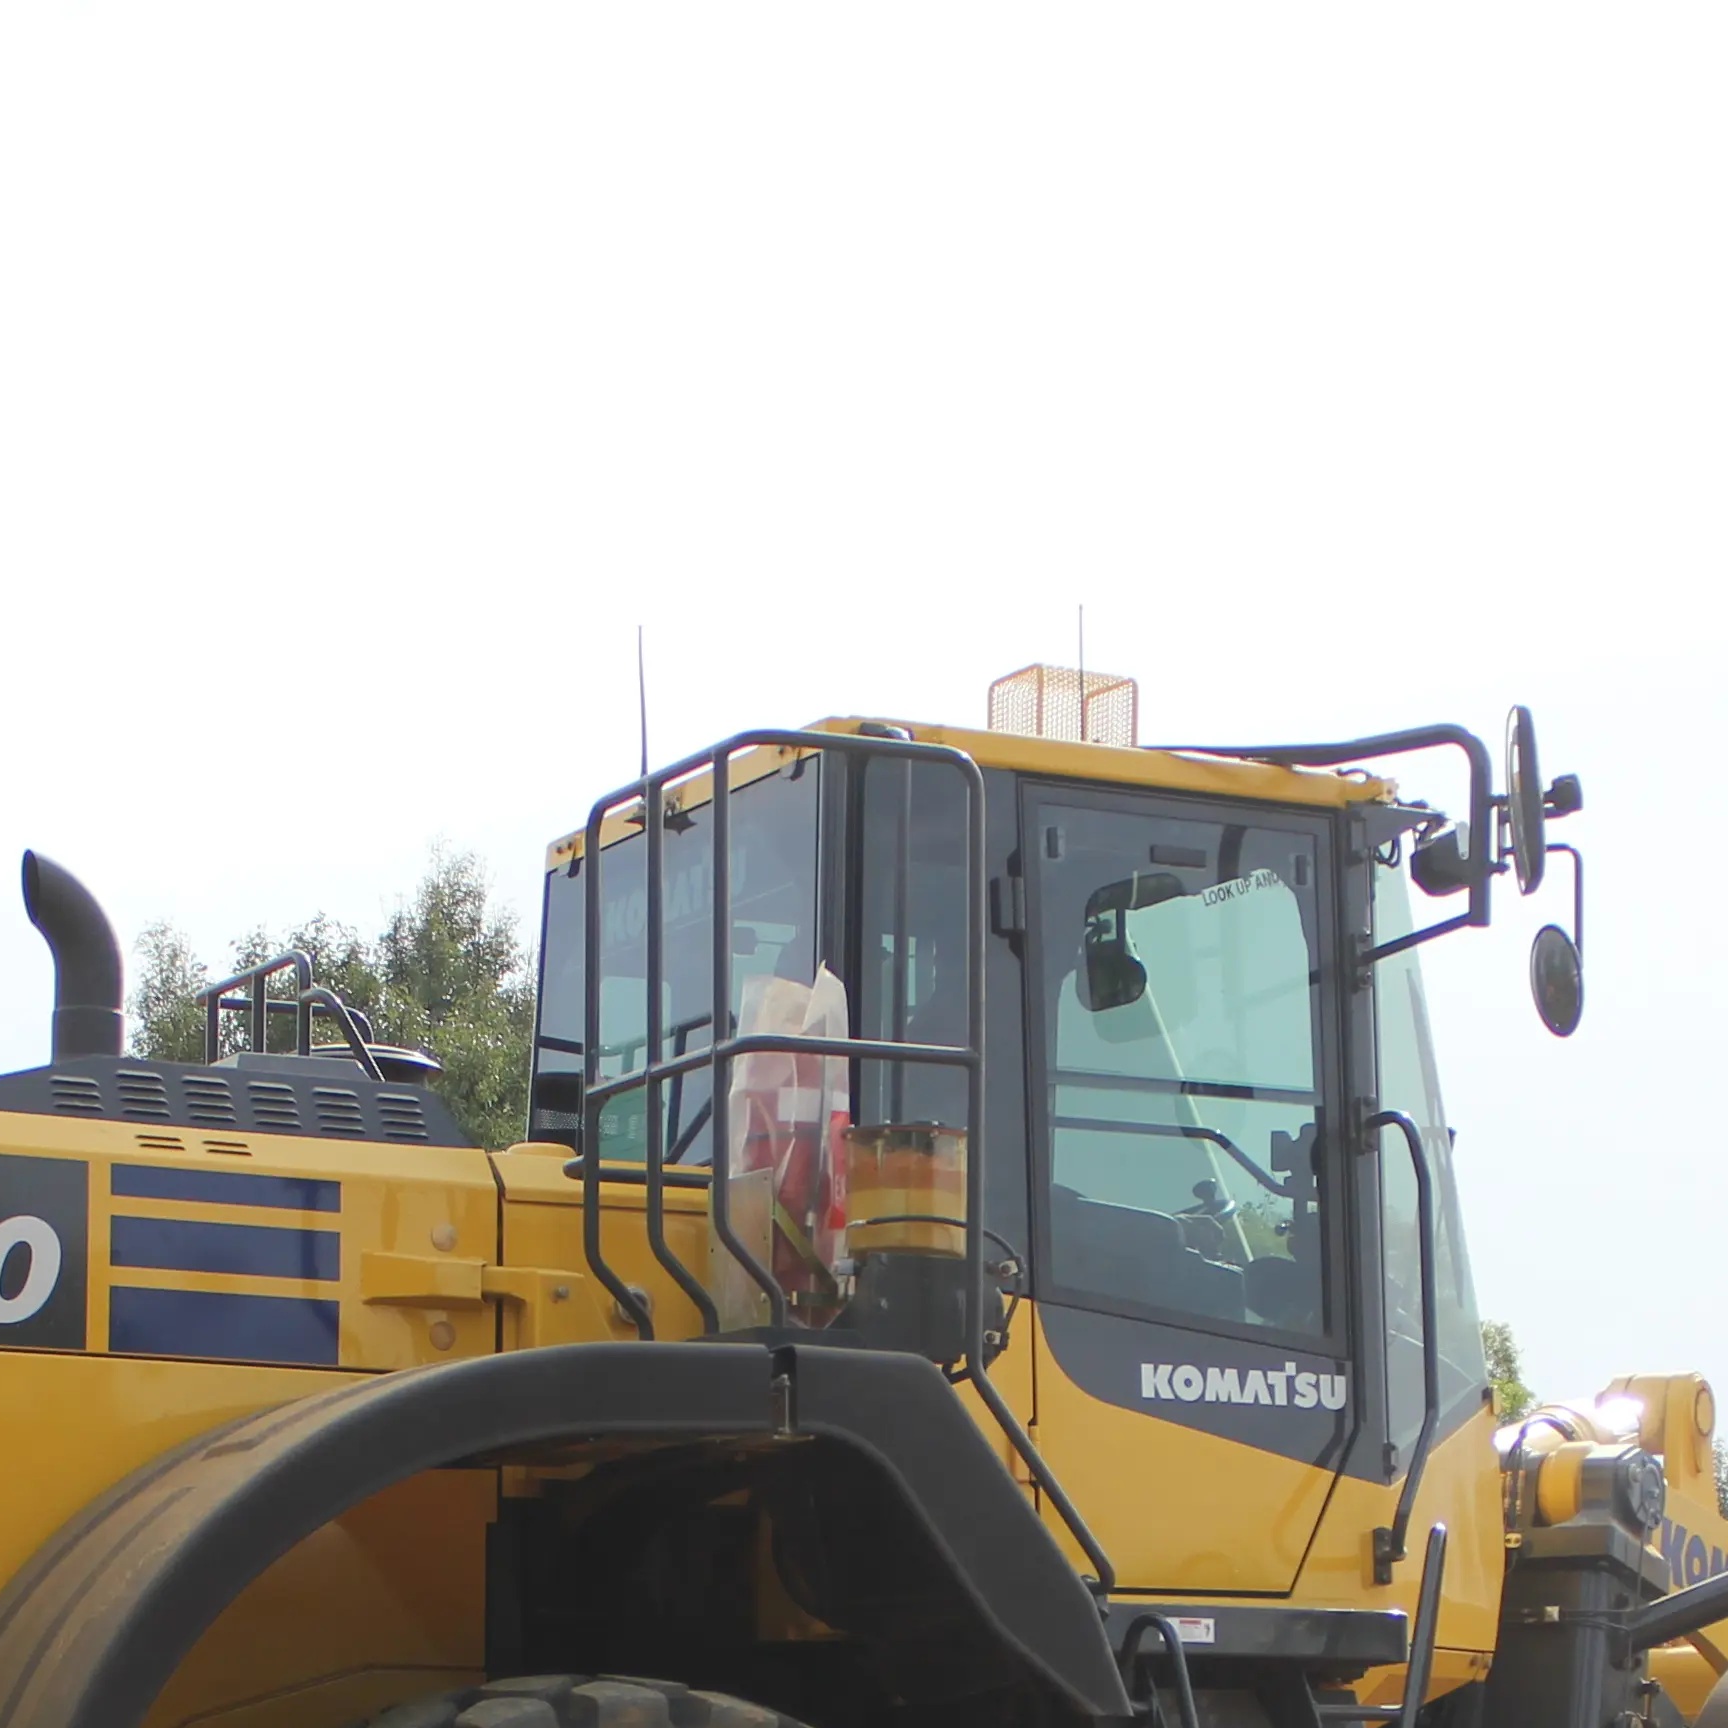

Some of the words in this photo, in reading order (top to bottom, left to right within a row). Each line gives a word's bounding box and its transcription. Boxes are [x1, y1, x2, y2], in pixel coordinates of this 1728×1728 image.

[1202, 883, 1235, 907] LOOK
[1235, 879, 1253, 896] UP
[1140, 1361, 1347, 1411] KOMATSU
